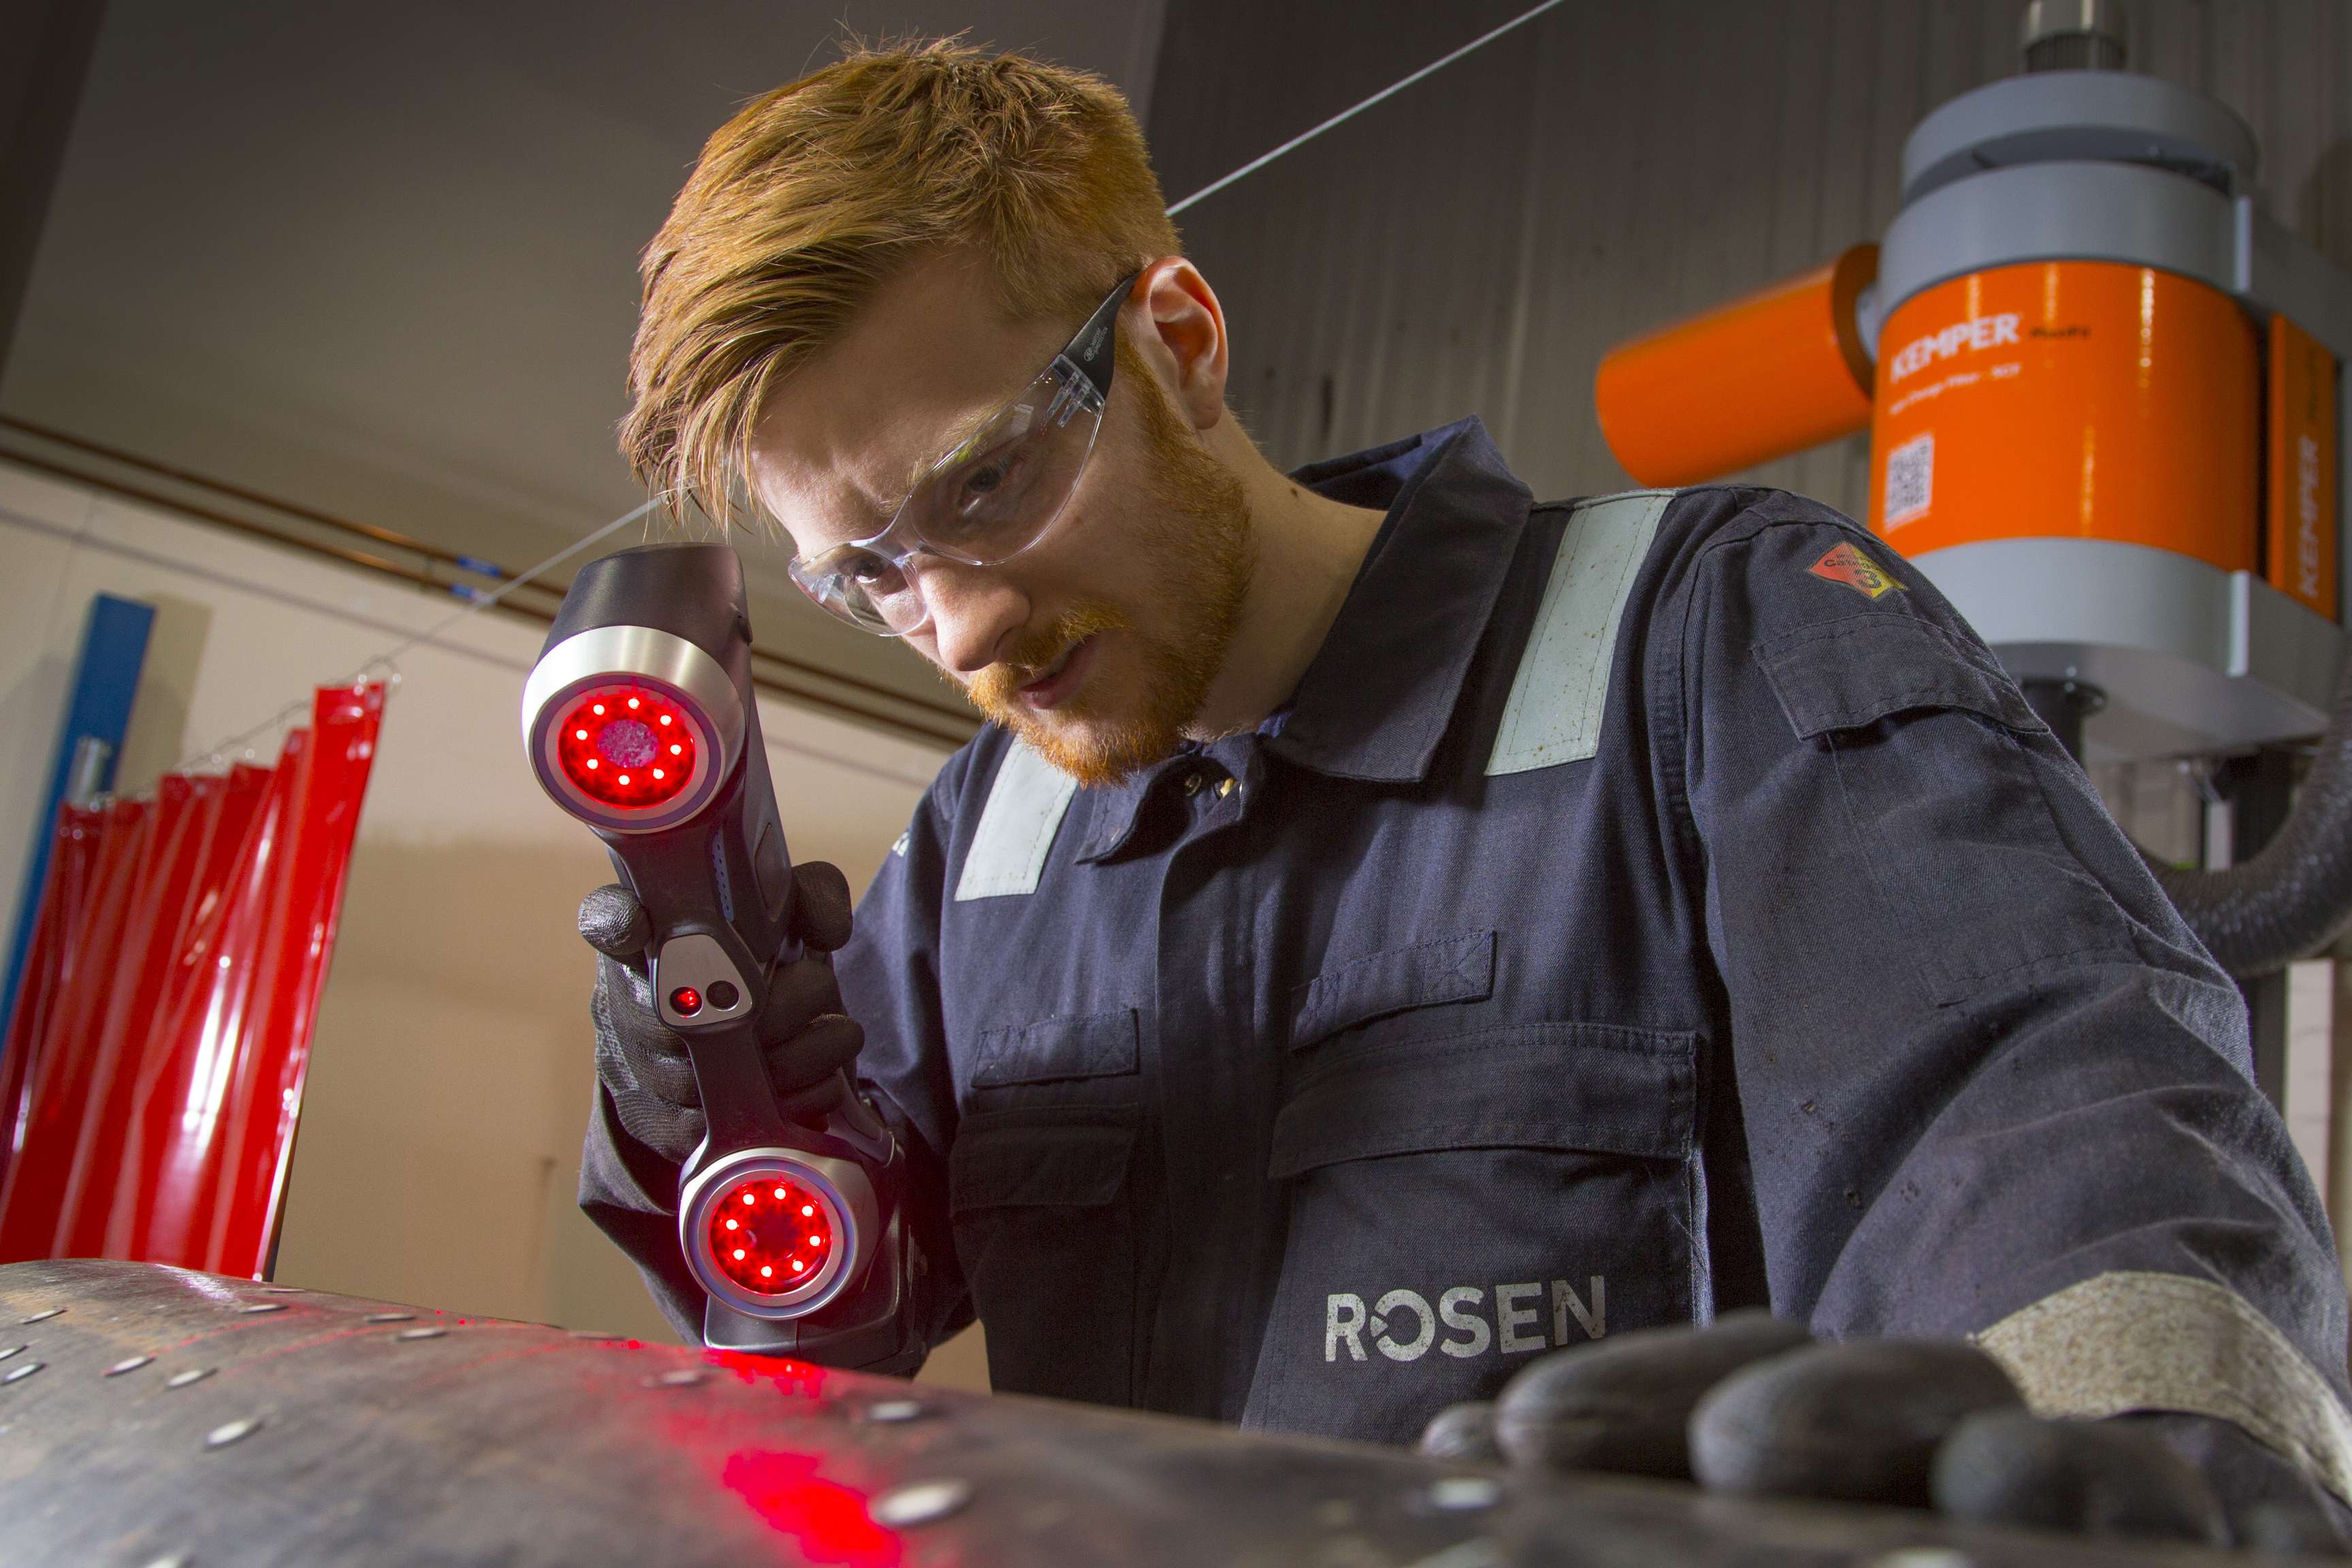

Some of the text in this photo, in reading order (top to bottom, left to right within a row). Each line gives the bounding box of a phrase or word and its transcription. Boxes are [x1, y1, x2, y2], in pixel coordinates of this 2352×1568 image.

[1891, 312, 2021, 385] KEMPER
[2298, 436, 2319, 599] KEMPER
[1326, 1275, 1606, 1362] ROSEN
